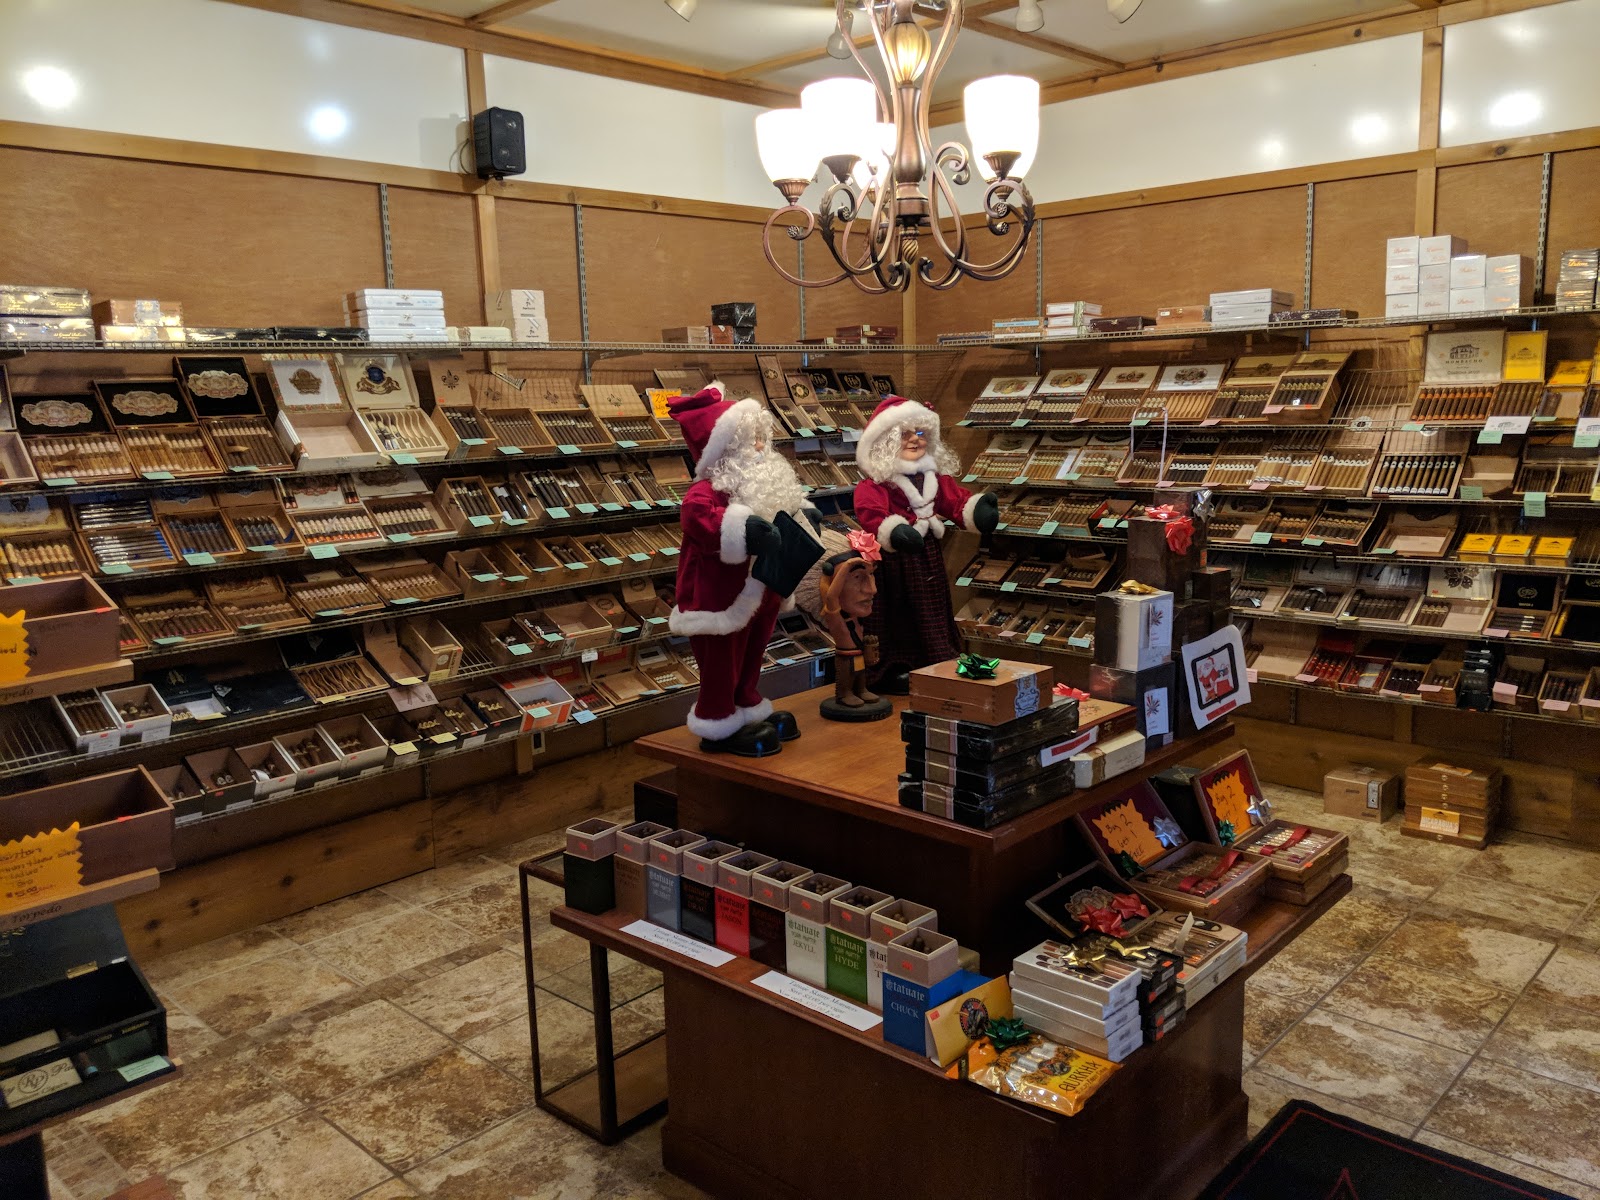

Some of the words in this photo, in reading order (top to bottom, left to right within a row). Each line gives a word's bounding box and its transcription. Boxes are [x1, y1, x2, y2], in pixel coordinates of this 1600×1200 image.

[1226, 785, 1236, 799] 2
[1119, 813, 1133, 828] 2
[12, 904, 62, 923] Torpedo
[792, 939, 817, 954] JEKYLL
[836, 936, 865, 954] tatuaje
[834, 954, 860, 970] HYDE
[893, 981, 926, 1003] tatuaje
[890, 1001, 920, 1020] CHUCK
[1058, 1060, 1103, 1094] GURKHA
